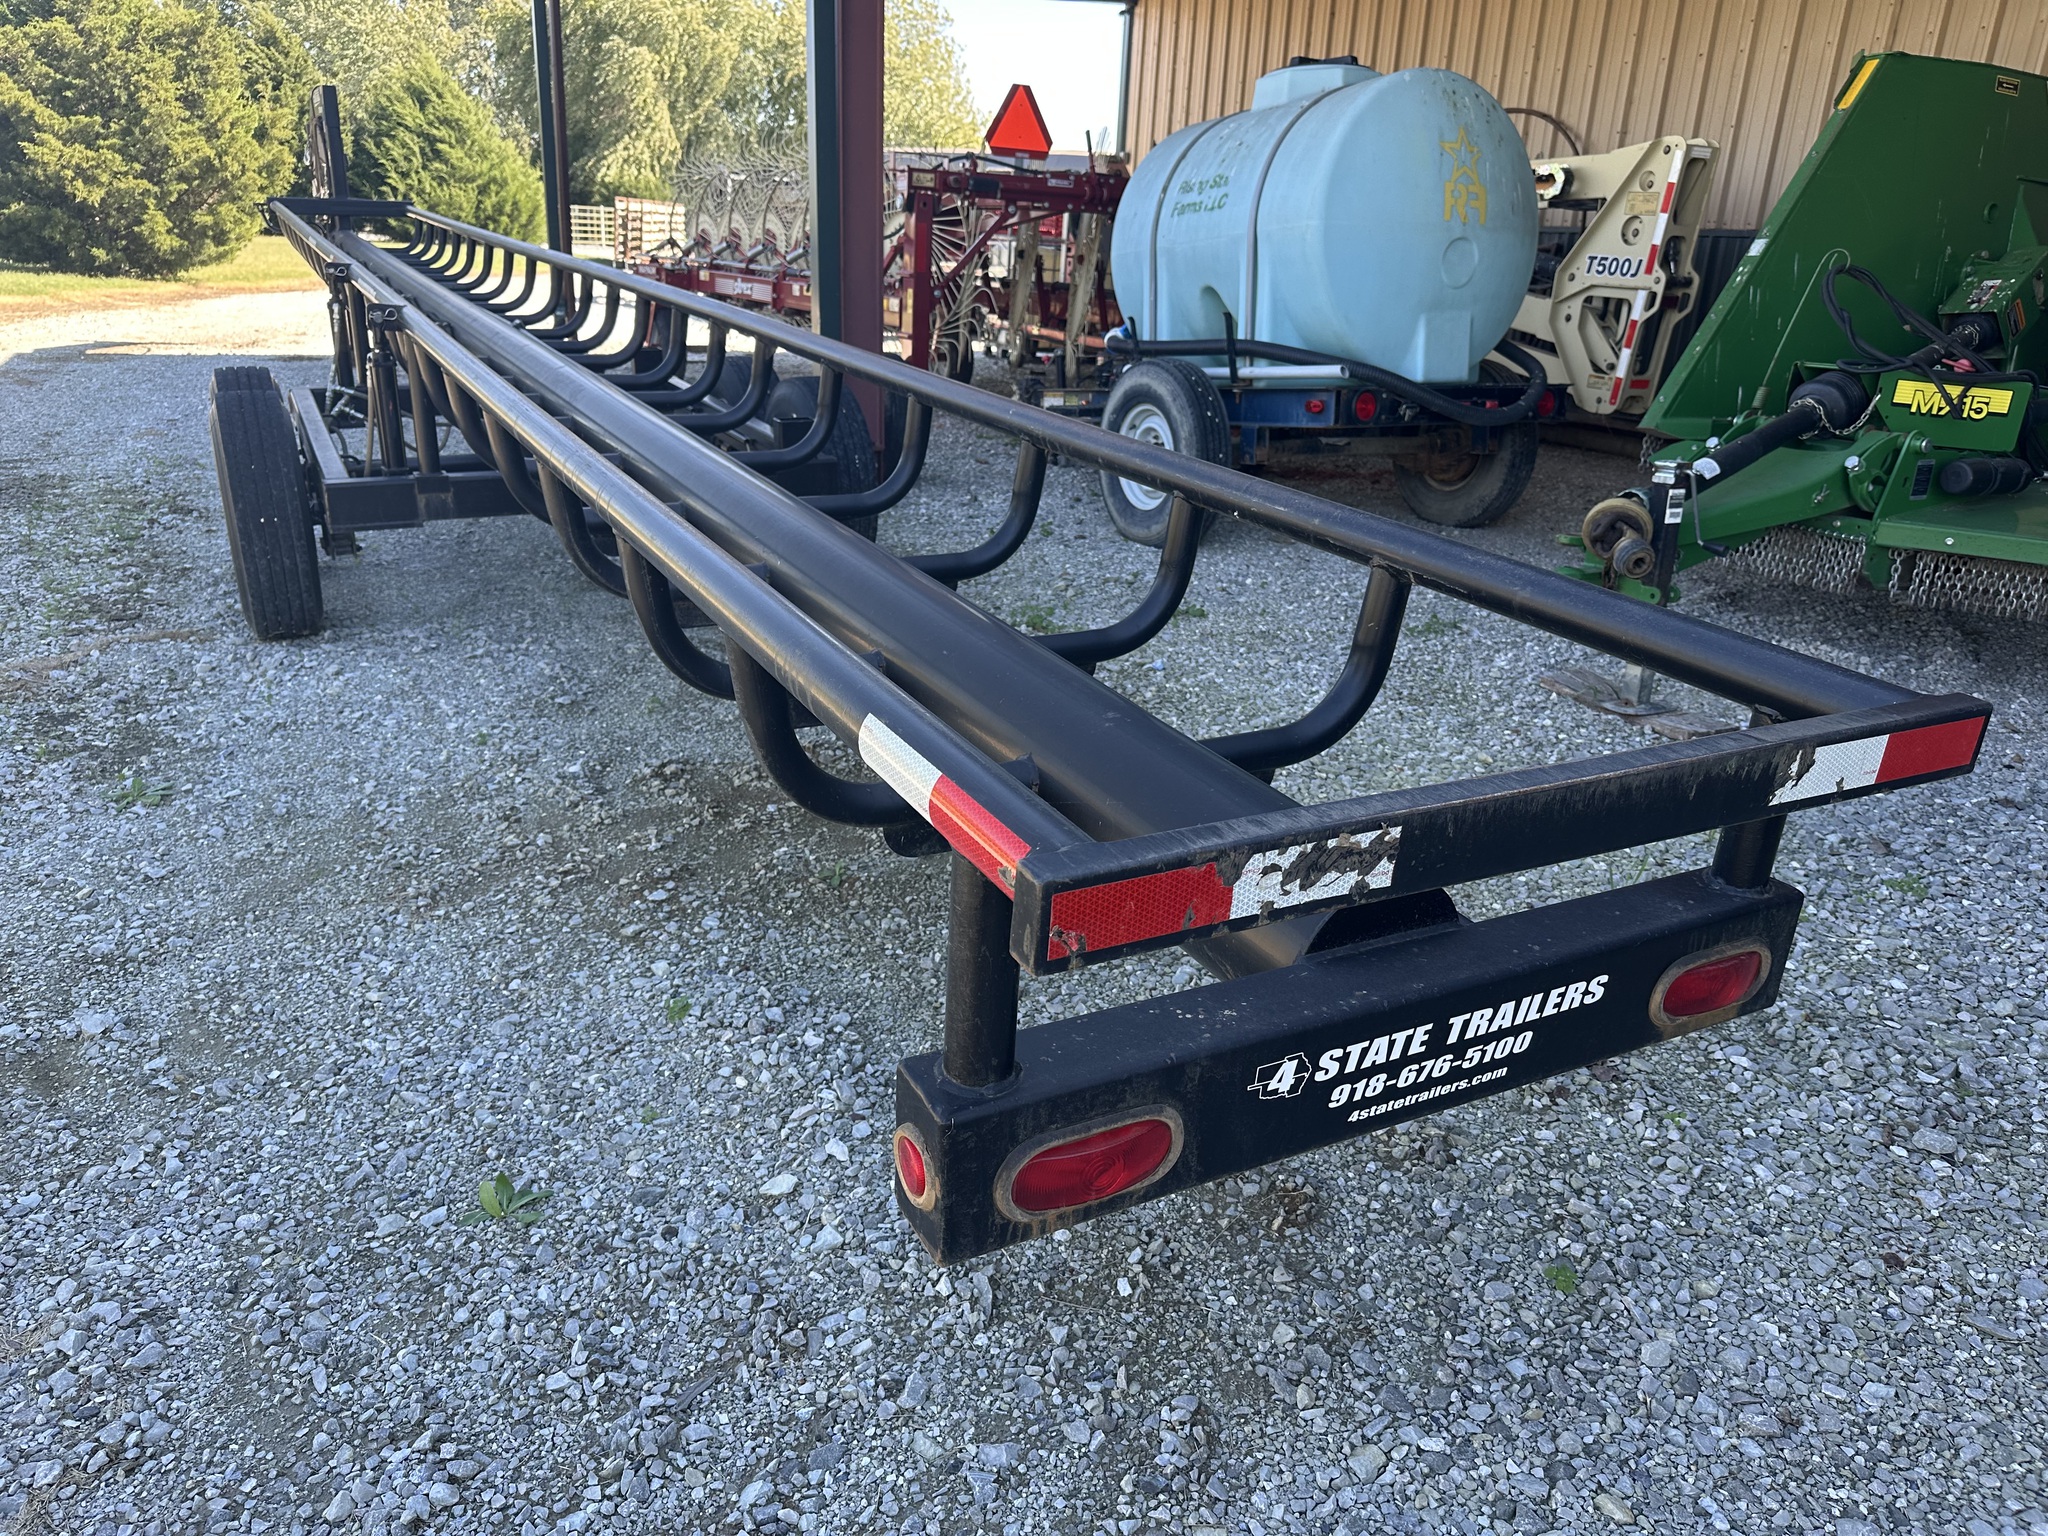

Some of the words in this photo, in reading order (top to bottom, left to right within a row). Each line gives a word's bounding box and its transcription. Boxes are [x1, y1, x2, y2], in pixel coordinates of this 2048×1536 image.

[1585, 255, 1644, 278] T500J
[1267, 1059, 1299, 1093] 4
[1314, 1023, 1434, 1082] STATE
[1446, 974, 1609, 1045] TRAILERS
[1328, 1031, 1534, 1108] 918-676-5100
[1347, 1067, 1508, 1122] 4statetrailers.com
